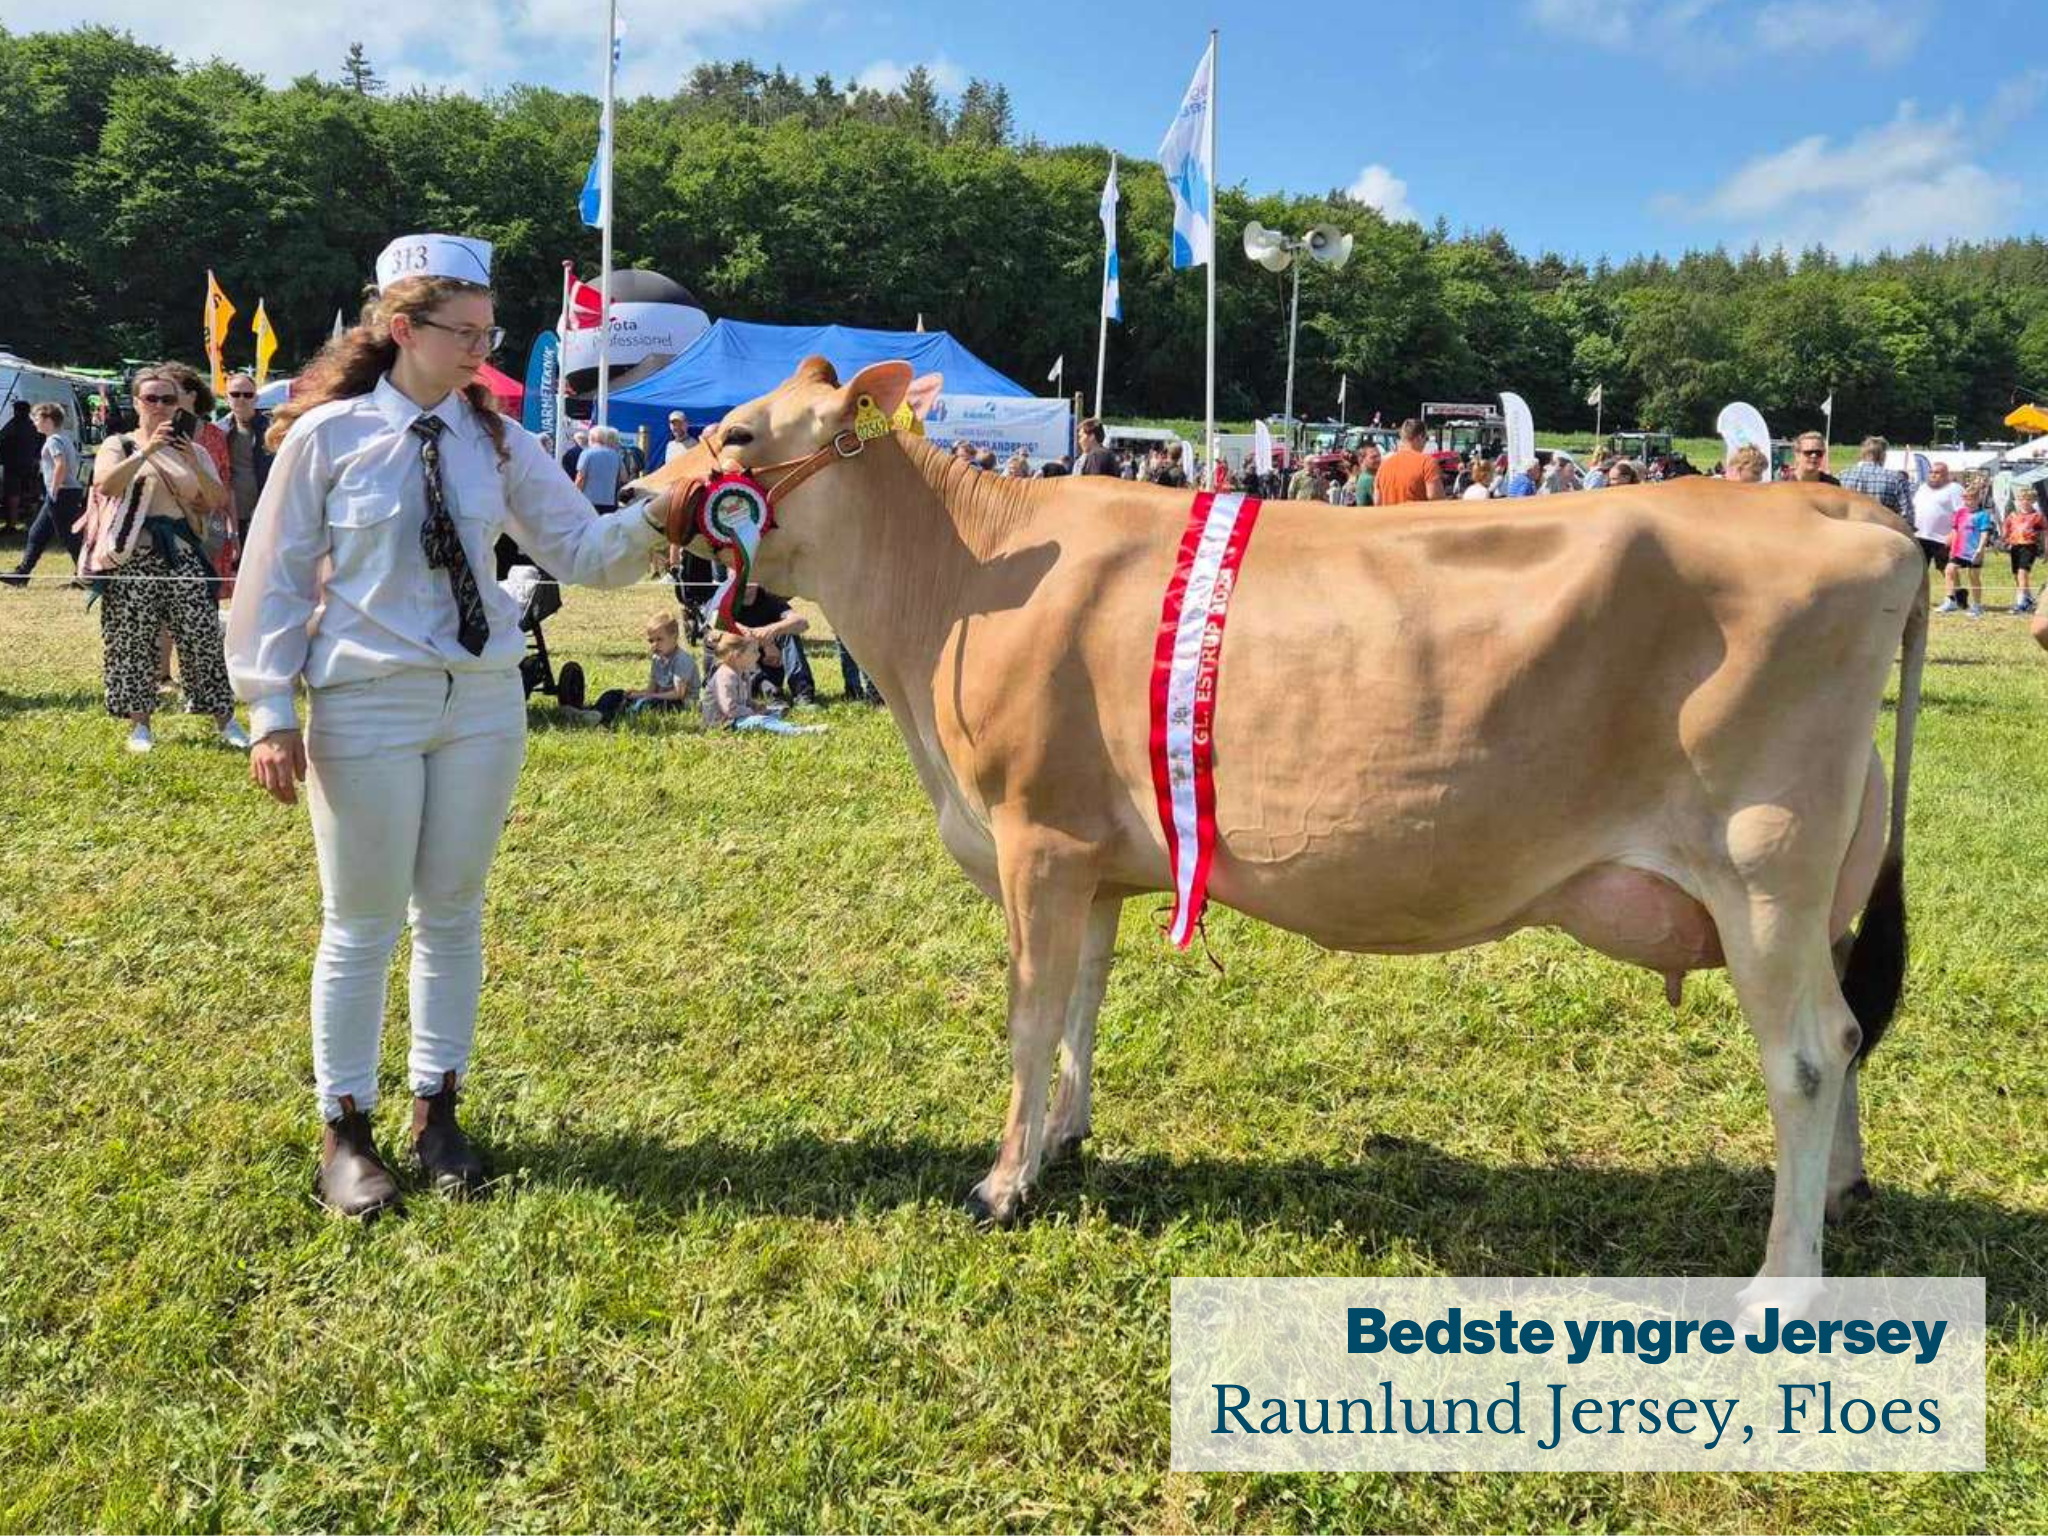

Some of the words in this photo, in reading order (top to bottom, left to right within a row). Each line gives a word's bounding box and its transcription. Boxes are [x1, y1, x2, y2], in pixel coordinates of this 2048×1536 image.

[391, 246, 427, 275] 313
[593, 333, 672, 347] pfessionel
[1197, 621, 1222, 702] ESTRUP
[1194, 711, 1210, 744] GL.
